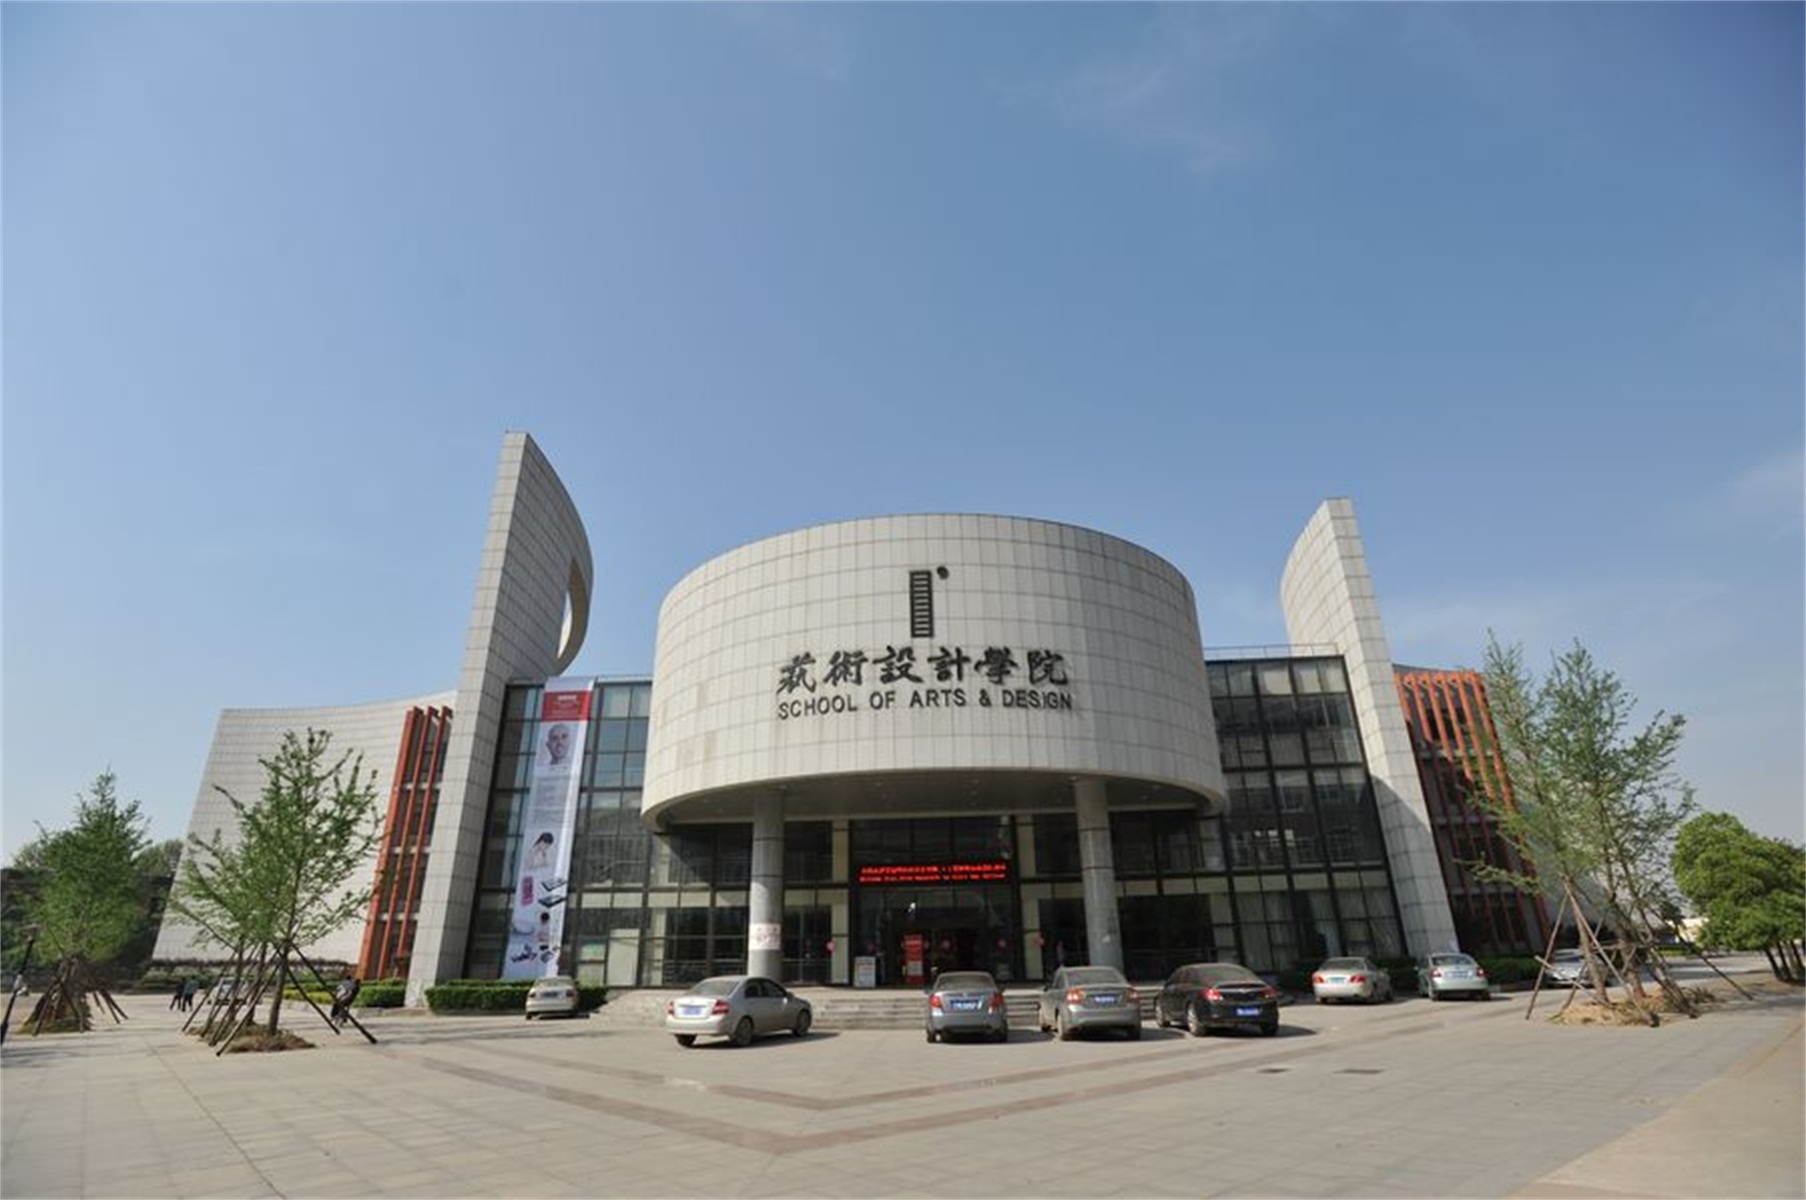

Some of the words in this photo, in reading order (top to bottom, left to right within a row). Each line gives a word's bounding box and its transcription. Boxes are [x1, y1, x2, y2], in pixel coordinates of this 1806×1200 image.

[777, 694, 859, 721] SCHOOL
[869, 690, 897, 711] OF
[909, 688, 967, 709] ARTS
[978, 688, 993, 708] &
[1002, 689, 1073, 710] DESIGN
